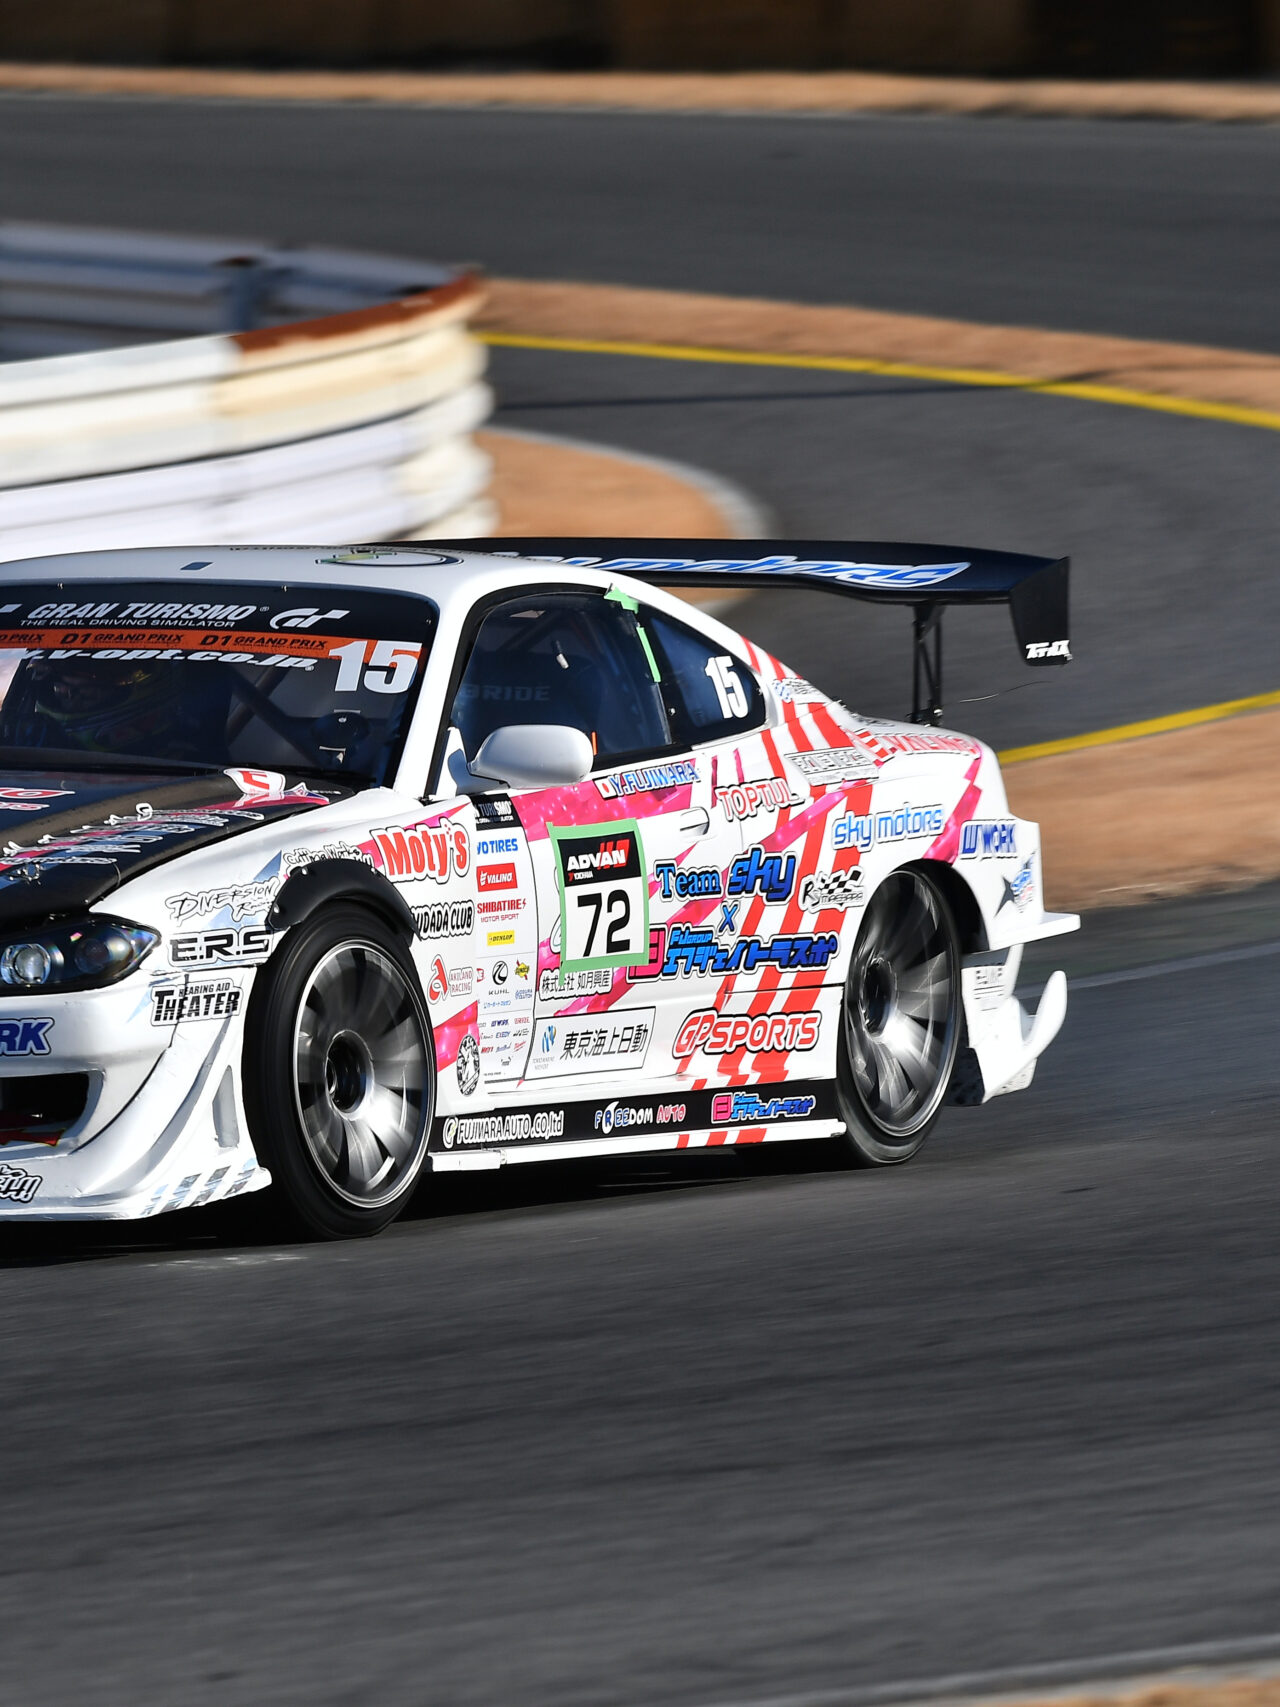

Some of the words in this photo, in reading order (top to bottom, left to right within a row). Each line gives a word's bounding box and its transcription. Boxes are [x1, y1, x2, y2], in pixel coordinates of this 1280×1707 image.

[20, 619, 45, 627] THE
[46, 619, 86, 627] REAL
[90, 619, 148, 627] DRIVING
[151, 618, 236, 628] SIMULATOR
[27, 603, 120, 620] GRAN
[120, 603, 257, 622] TURISMO
[9, 633, 45, 643] PRIX
[60, 632, 92, 645] D1
[94, 633, 148, 643] GRAND
[149, 633, 184, 643] PRIX
[199, 634, 232, 646] D1
[233, 635, 289, 646] GRAND
[290, 638, 328, 648] PRIX
[328, 640, 423, 694] 15
[705, 655, 749, 720] 15
[717, 781, 799, 818] TOPTUL
[833, 815, 871, 850] sky
[876, 803, 945, 838] motors
[376, 823, 468, 876] Moty's
[489, 838, 519, 853] TIRES
[567, 849, 626, 871] ADVAN
[487, 872, 513, 884] VALINO
[656, 864, 721, 899] Team
[727, 847, 796, 902] sky
[170, 883, 279, 921] DIVERSION
[477, 898, 523, 914] SHIBATIRE
[450, 906, 473, 931] CLUB
[577, 889, 631, 957] 72
[169, 927, 270, 963] E.R.S
[178, 983, 215, 998] HEARING
[216, 981, 231, 992] AID
[153, 991, 242, 1022] THEATER
[559, 1022, 650, 1061] 東京海上日動
[594, 1100, 654, 1134] FREEDOM
[656, 1104, 687, 1126] AUTO
